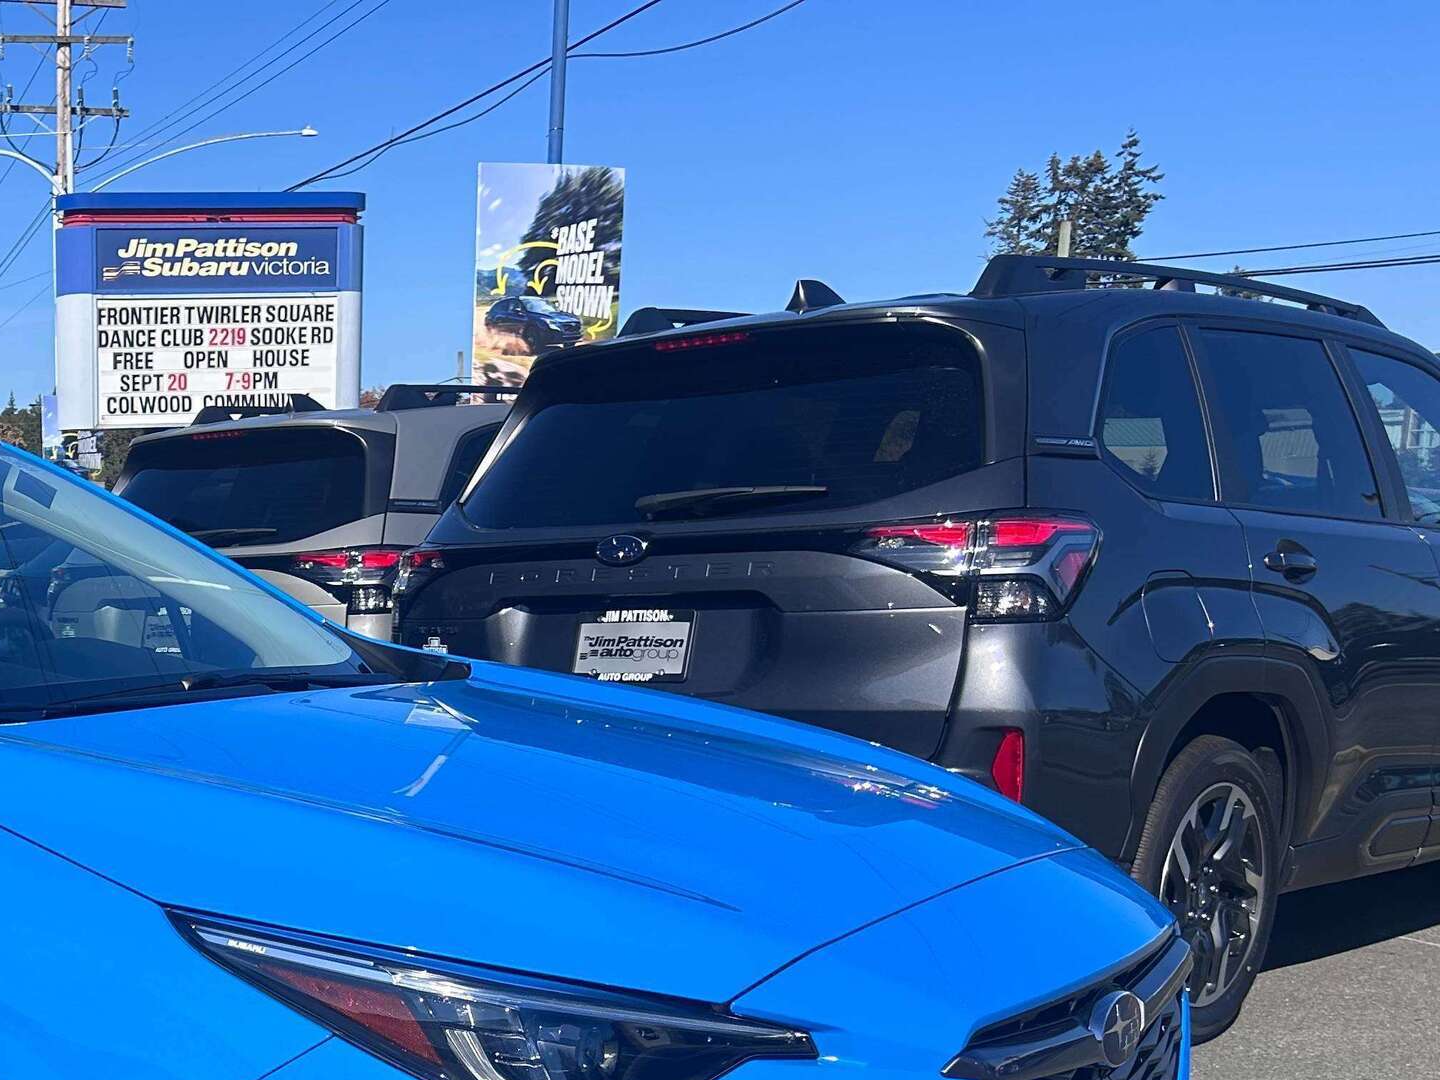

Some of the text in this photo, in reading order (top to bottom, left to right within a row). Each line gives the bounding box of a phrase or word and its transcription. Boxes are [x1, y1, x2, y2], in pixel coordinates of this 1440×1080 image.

[555, 251, 605, 285] MODEL
[555, 285, 615, 319] SHOWN
[98, 304, 335, 326] FRONTIER TWIRLER SQUARE
[98, 326, 334, 348] DANCE CLUB 2219 SOOKE RD
[113, 349, 310, 370] FREE OPEN HOUSE
[120, 371, 278, 392] SEPT 20 7-9PM
[107, 395, 192, 414] COLWOOD
[489, 561, 777, 585] FORESTER
[602, 610, 670, 622] JIM PATTISON
[598, 673, 653, 682] AUTO GROUP
